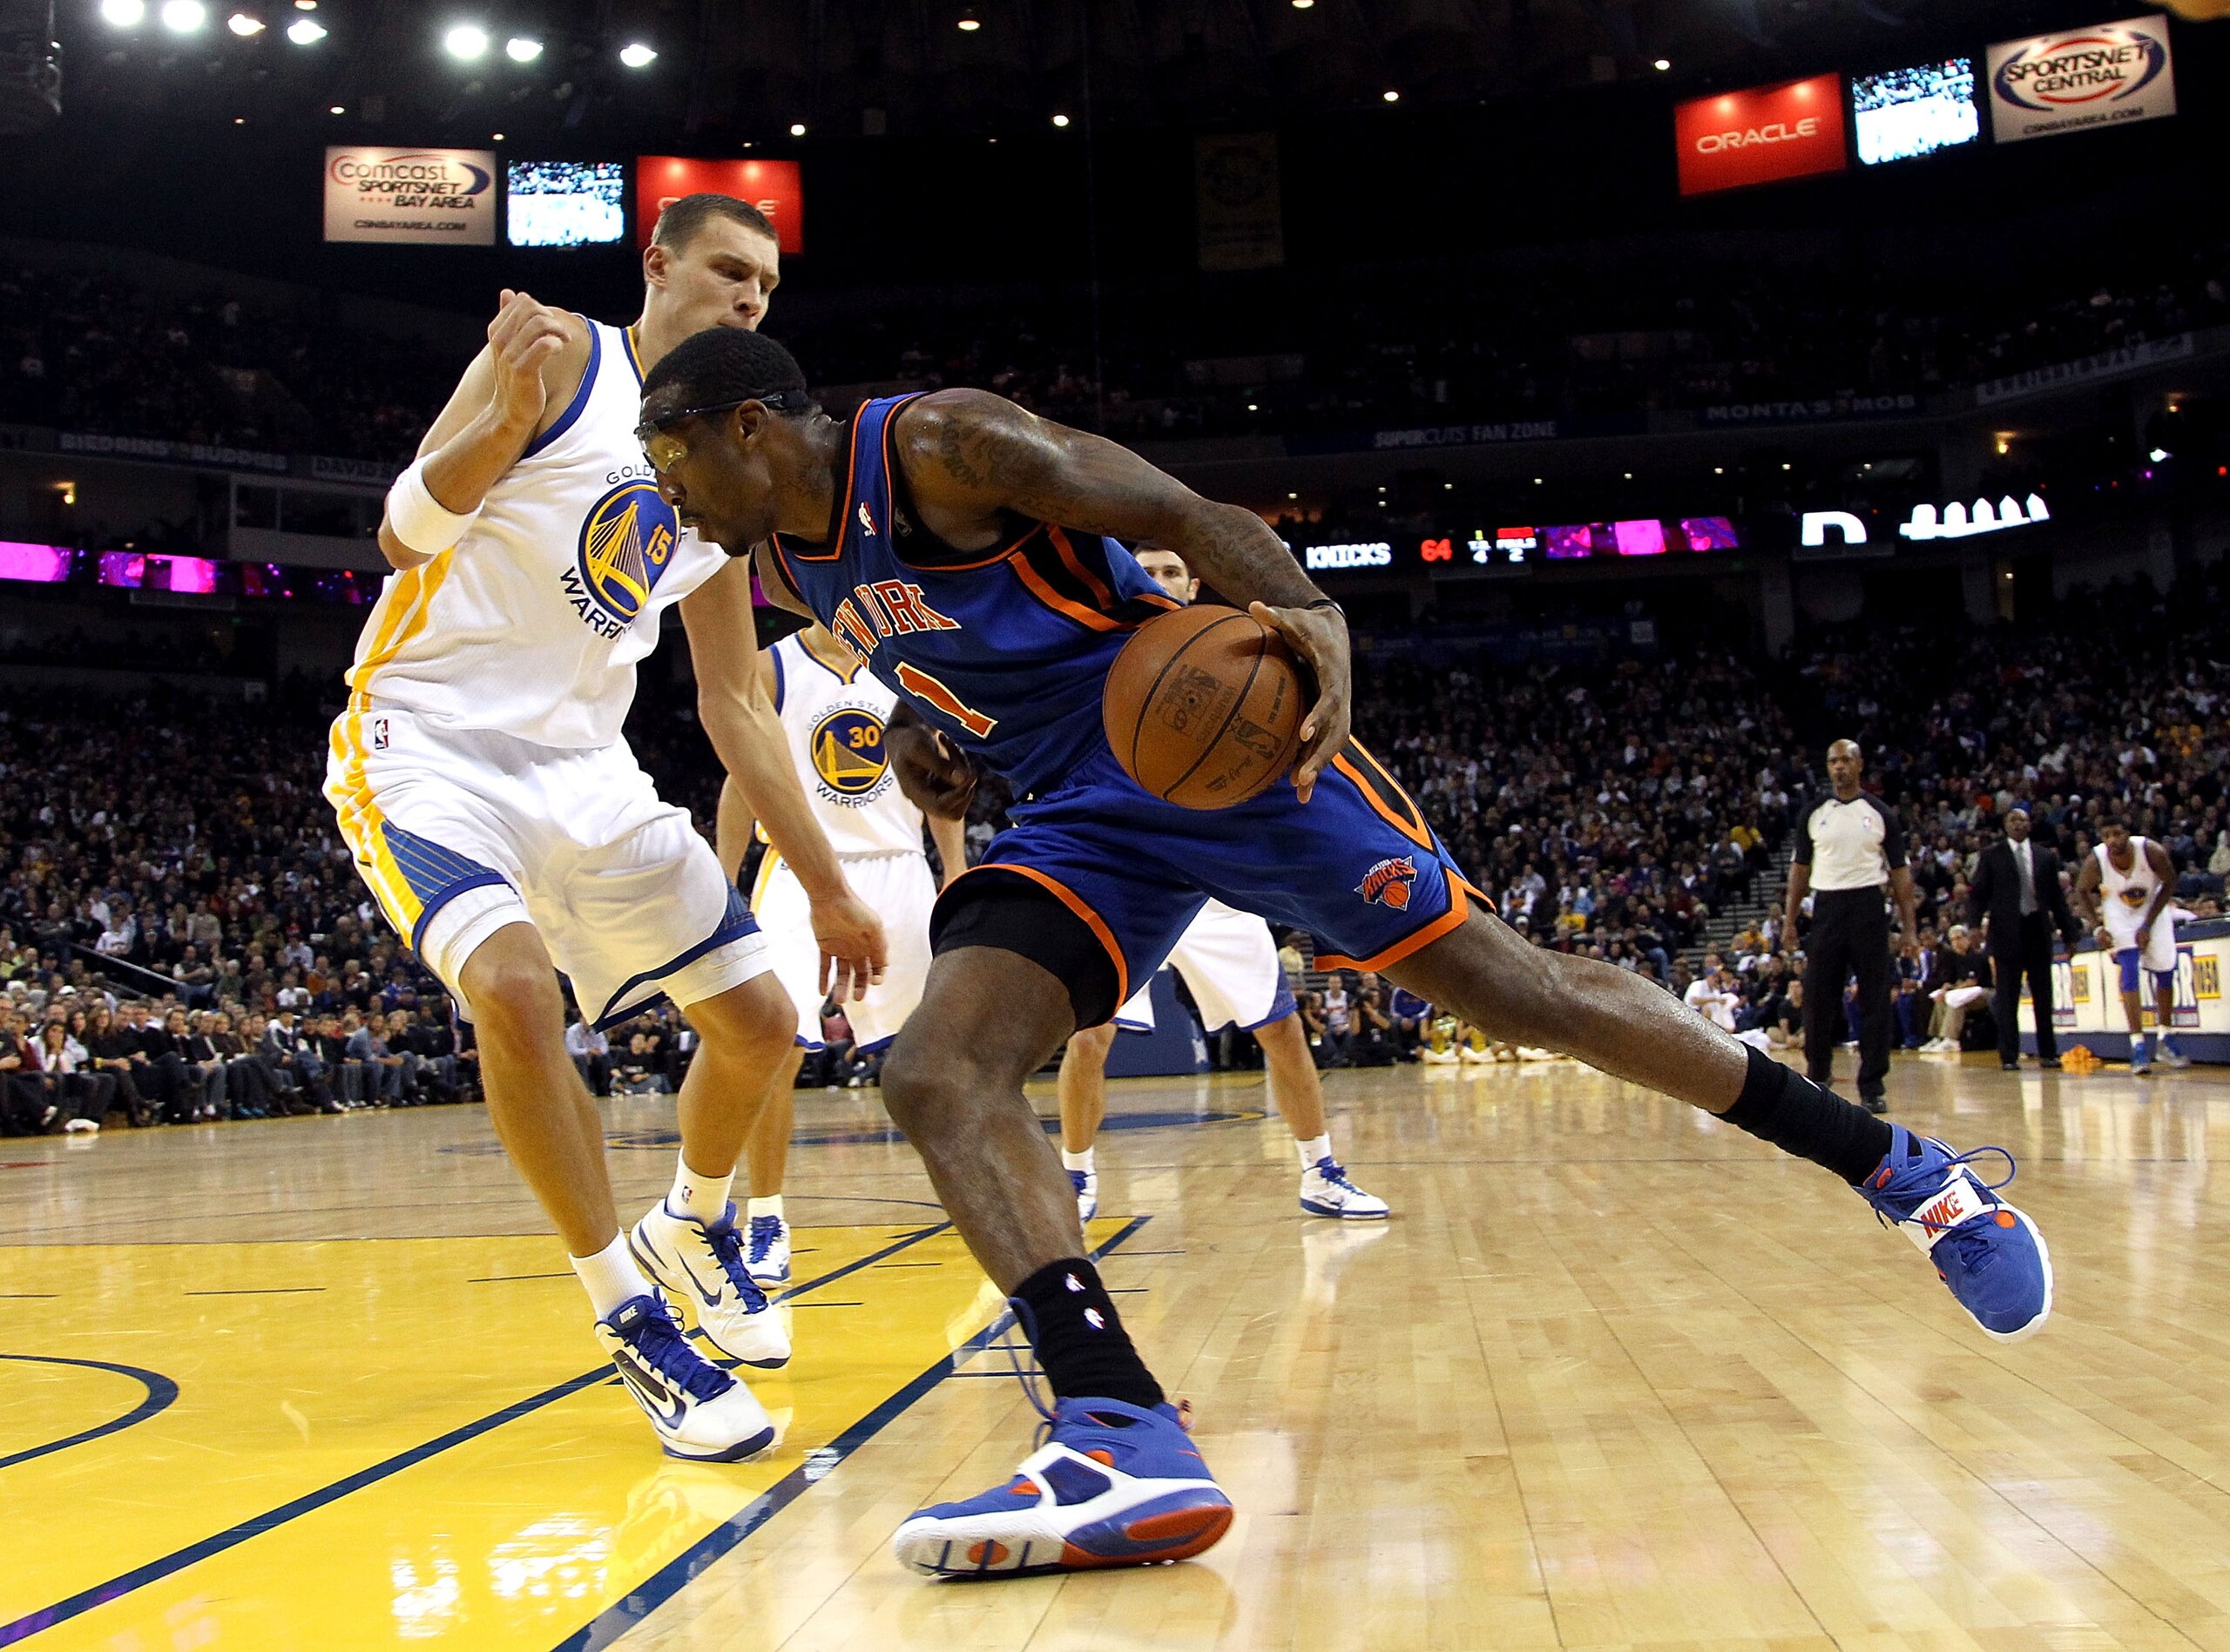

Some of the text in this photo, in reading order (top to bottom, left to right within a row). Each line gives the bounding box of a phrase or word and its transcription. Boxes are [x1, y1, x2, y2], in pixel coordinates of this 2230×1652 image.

[2005, 40, 2154, 82] SPORTSNET
[2034, 65, 2125, 92] CENTRAL
[1696, 117, 1818, 154] ORACLE
[358, 179, 461, 194] SPORTSNET
[395, 195, 475, 208] BAY AREA
[1374, 421, 1557, 448] SUPERCUTS FAN ZONE
[606, 463, 652, 484] GOLD
[645, 524, 674, 565] 15
[1306, 538, 1452, 569] KNICKS 64
[1509, 548, 1524, 562] 2
[808, 699, 853, 731] GOLDEN
[894, 660, 999, 740] 1
[848, 725, 881, 748] 30
[816, 774, 894, 808] WARRIORS
[1363, 859, 1416, 900] KNICKS
[1920, 1190, 1964, 1239] NIKE
